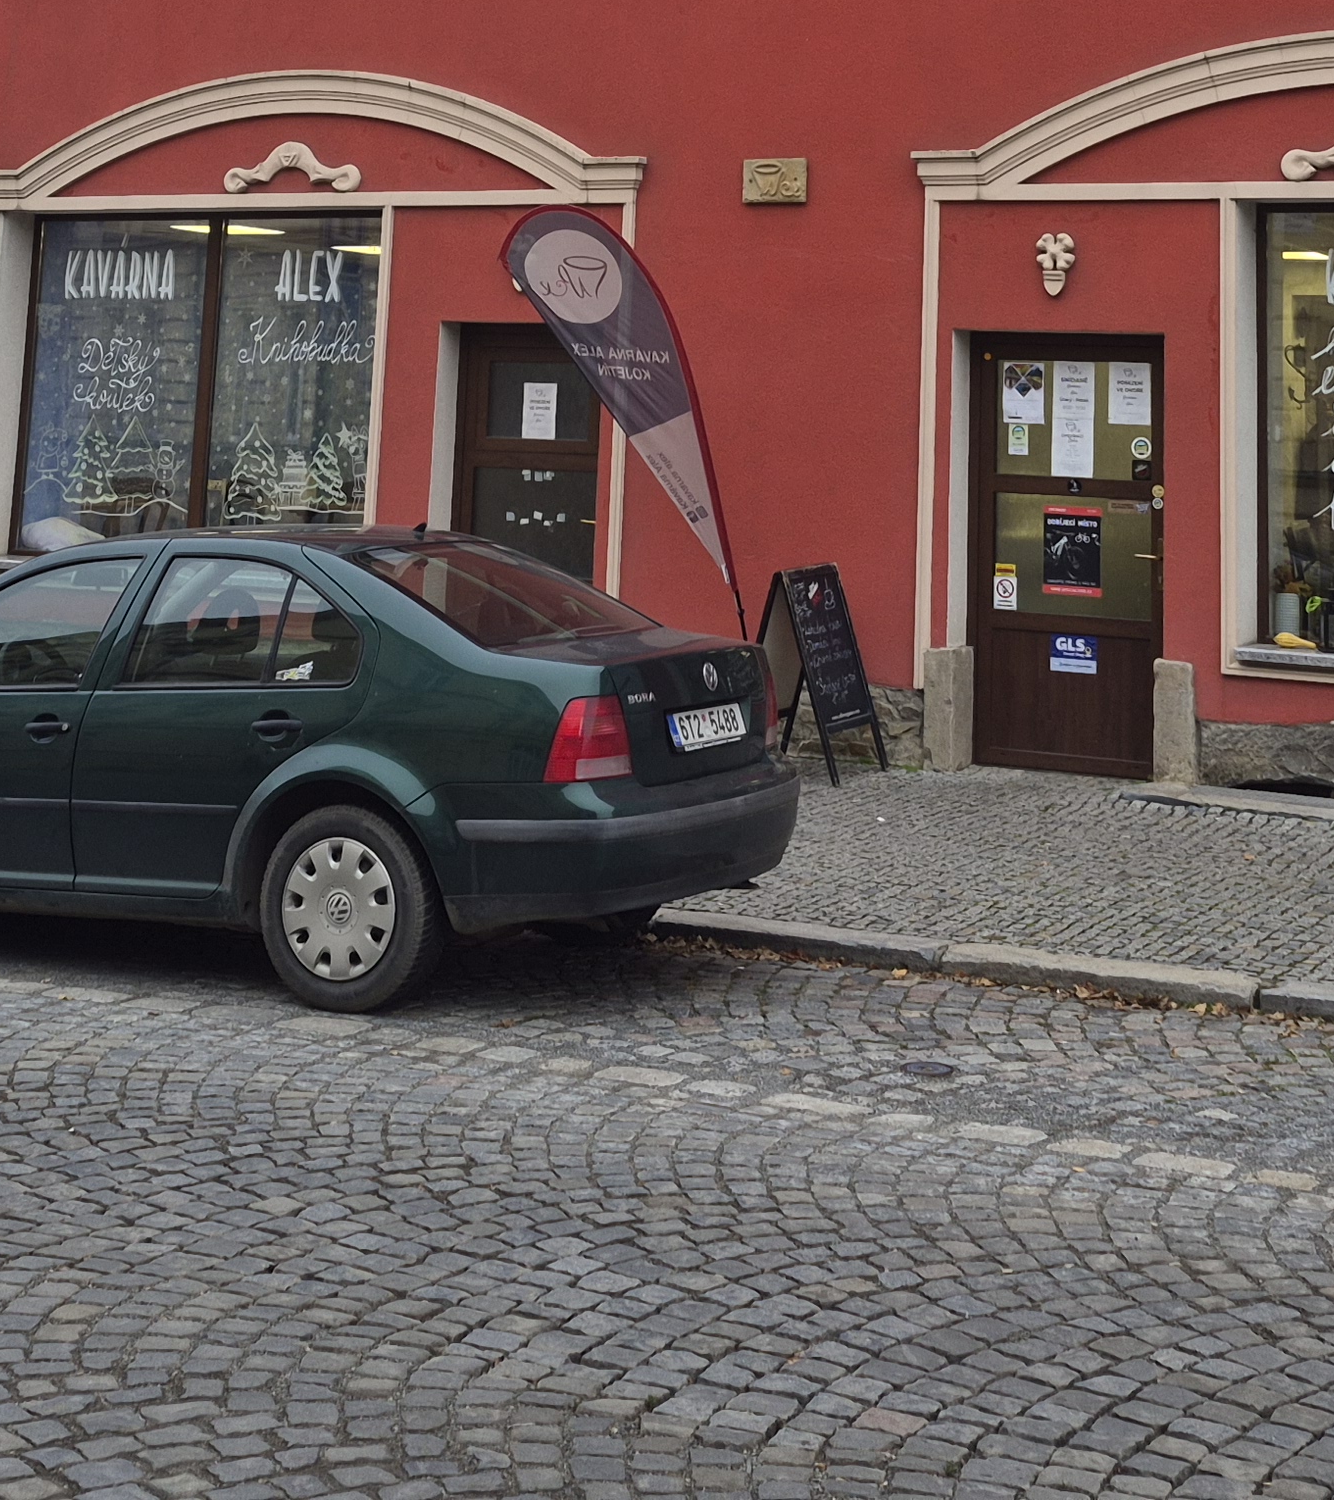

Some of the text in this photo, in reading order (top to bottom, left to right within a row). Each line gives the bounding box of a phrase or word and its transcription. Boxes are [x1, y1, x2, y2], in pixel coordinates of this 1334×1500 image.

[65, 233, 343, 302] KAVÁRNA ALEX
[238, 316, 375, 365] Knihobudka
[73, 376, 154, 413] koutek
[1055, 637, 1085, 652] GLS
[627, 691, 656, 704] BORA
[678, 708, 740, 741] 6T2 5488
